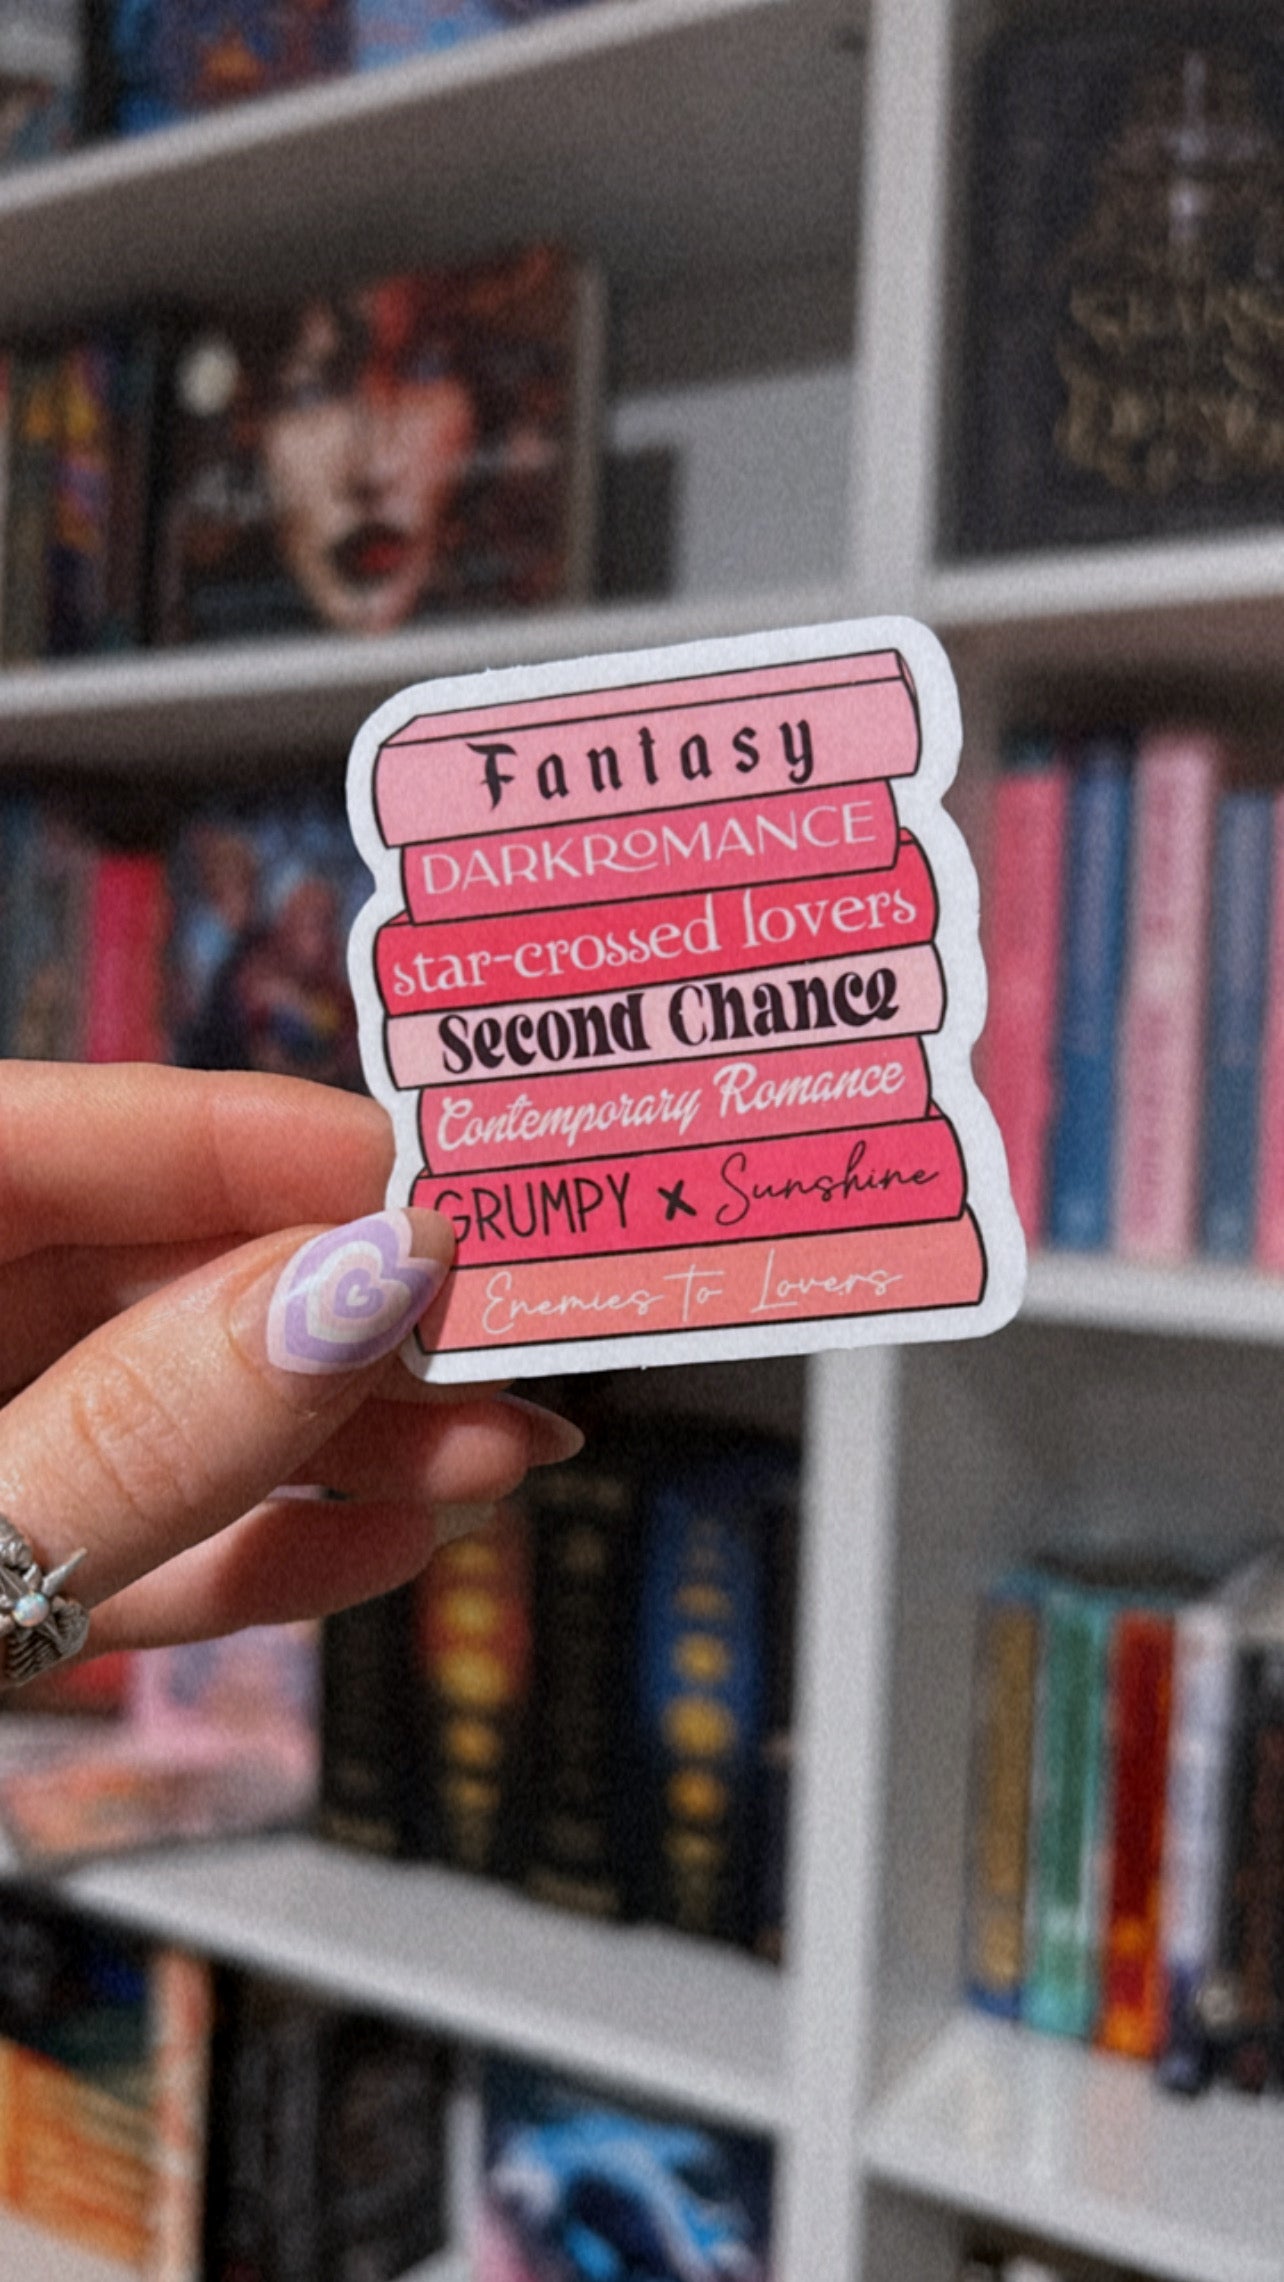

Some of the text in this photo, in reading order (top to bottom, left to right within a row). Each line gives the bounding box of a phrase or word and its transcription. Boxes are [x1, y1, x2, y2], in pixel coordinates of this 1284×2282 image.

[467, 719, 816, 810] Fantasy
[393, 888, 918, 996] star-crossed lovers
[438, 967, 899, 1074] Second Chance
[437, 1061, 904, 1151] Contemporary Romance
[434, 1172, 630, 1243] GRUMPY
[715, 1140, 940, 1226] Sunshine
[481, 1248, 904, 1335] Enemies To Lovers
